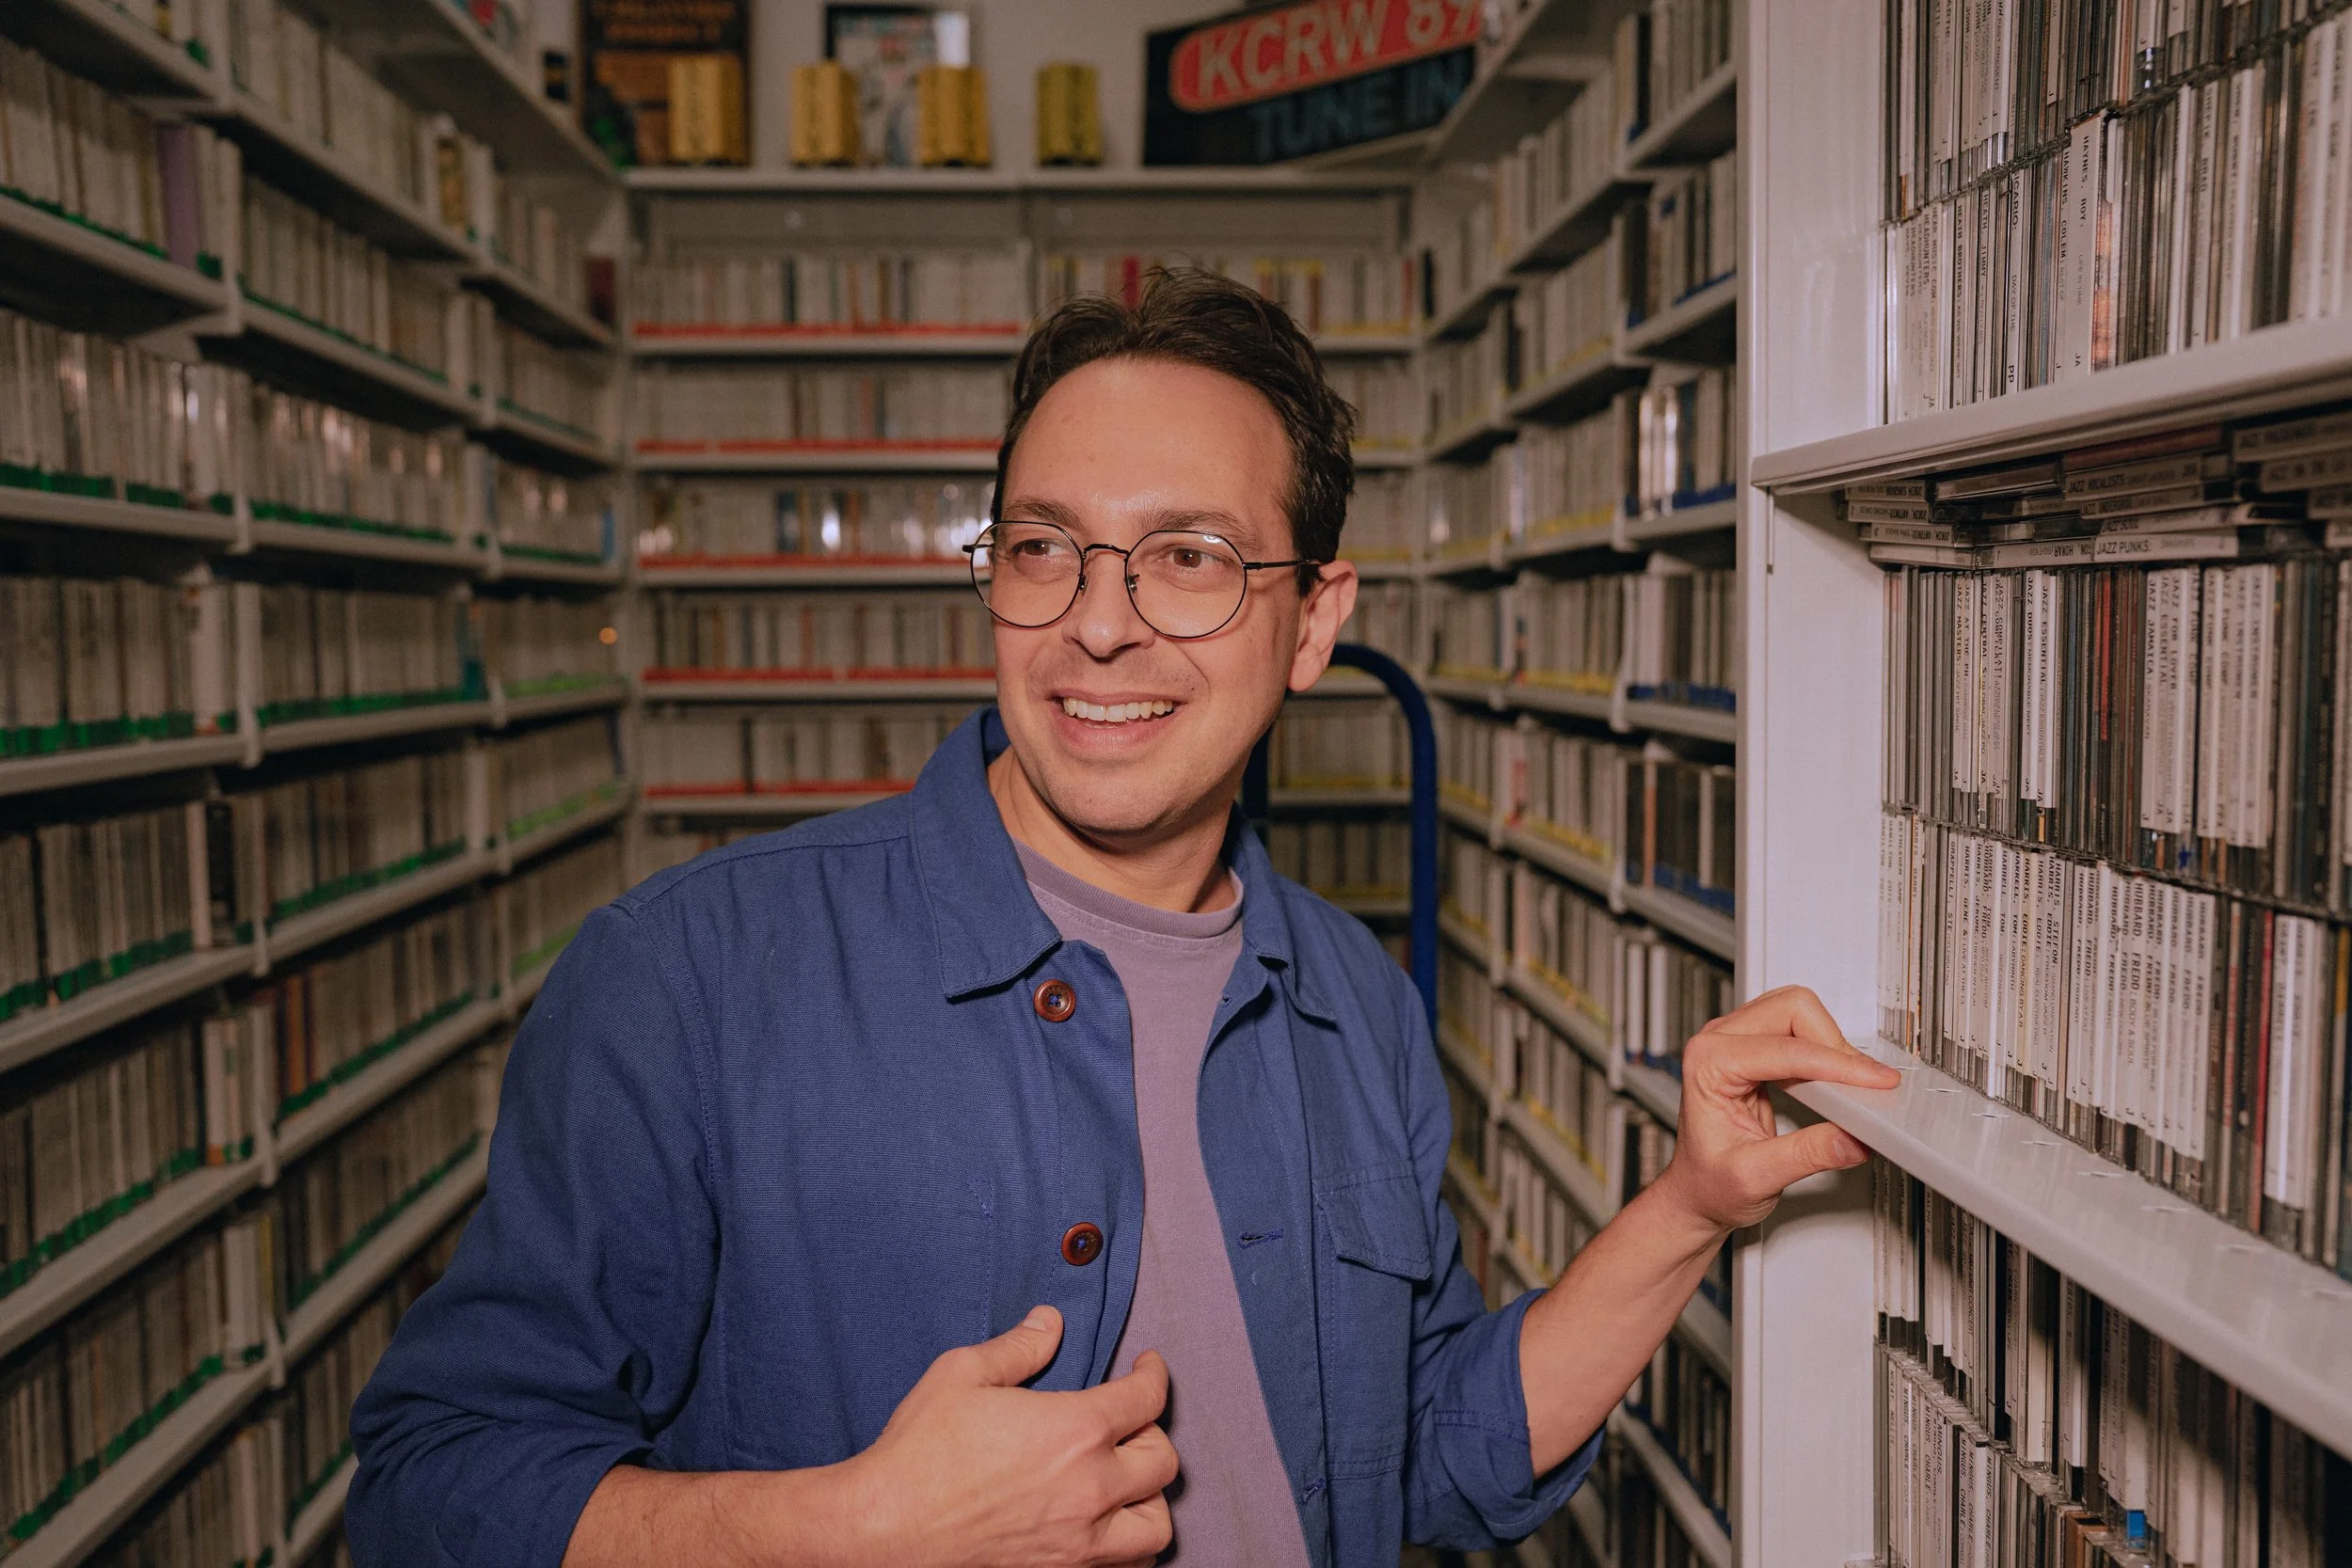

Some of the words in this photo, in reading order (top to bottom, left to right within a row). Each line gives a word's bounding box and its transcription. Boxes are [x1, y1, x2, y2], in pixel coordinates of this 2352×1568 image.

[1197, 0, 1387, 100] KCRW
[1246, 71, 1396, 160] TUNE
[2096, 542, 2118, 555] JAZZ
[2046, 856, 2055, 903] HARRIS,
[2053, 863, 2061, 911] HARRIS,
